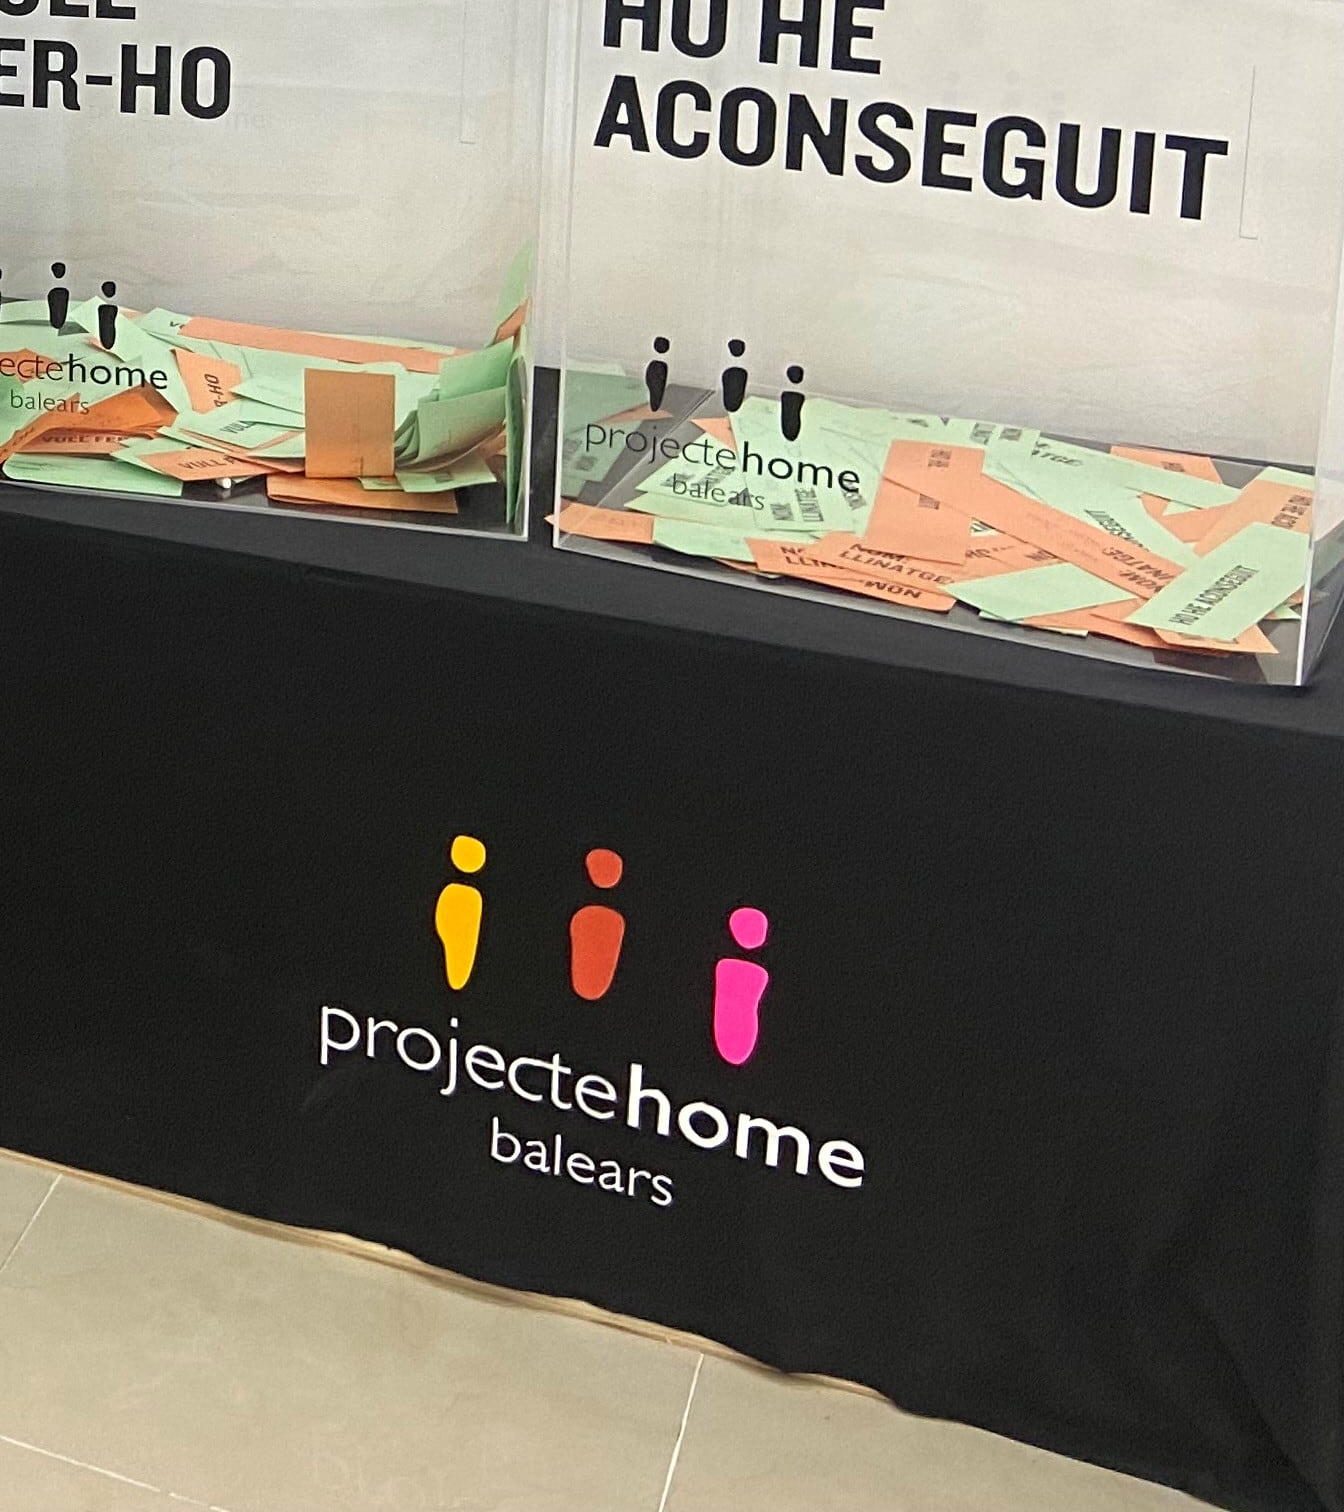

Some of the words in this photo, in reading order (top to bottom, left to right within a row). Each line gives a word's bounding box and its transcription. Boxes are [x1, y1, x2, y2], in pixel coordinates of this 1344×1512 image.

[594, 74, 1229, 220] ACONSEGUIT
[11, 389, 90, 415] balears
[672, 473, 765, 510] balears
[490, 1117, 674, 1207] balears
